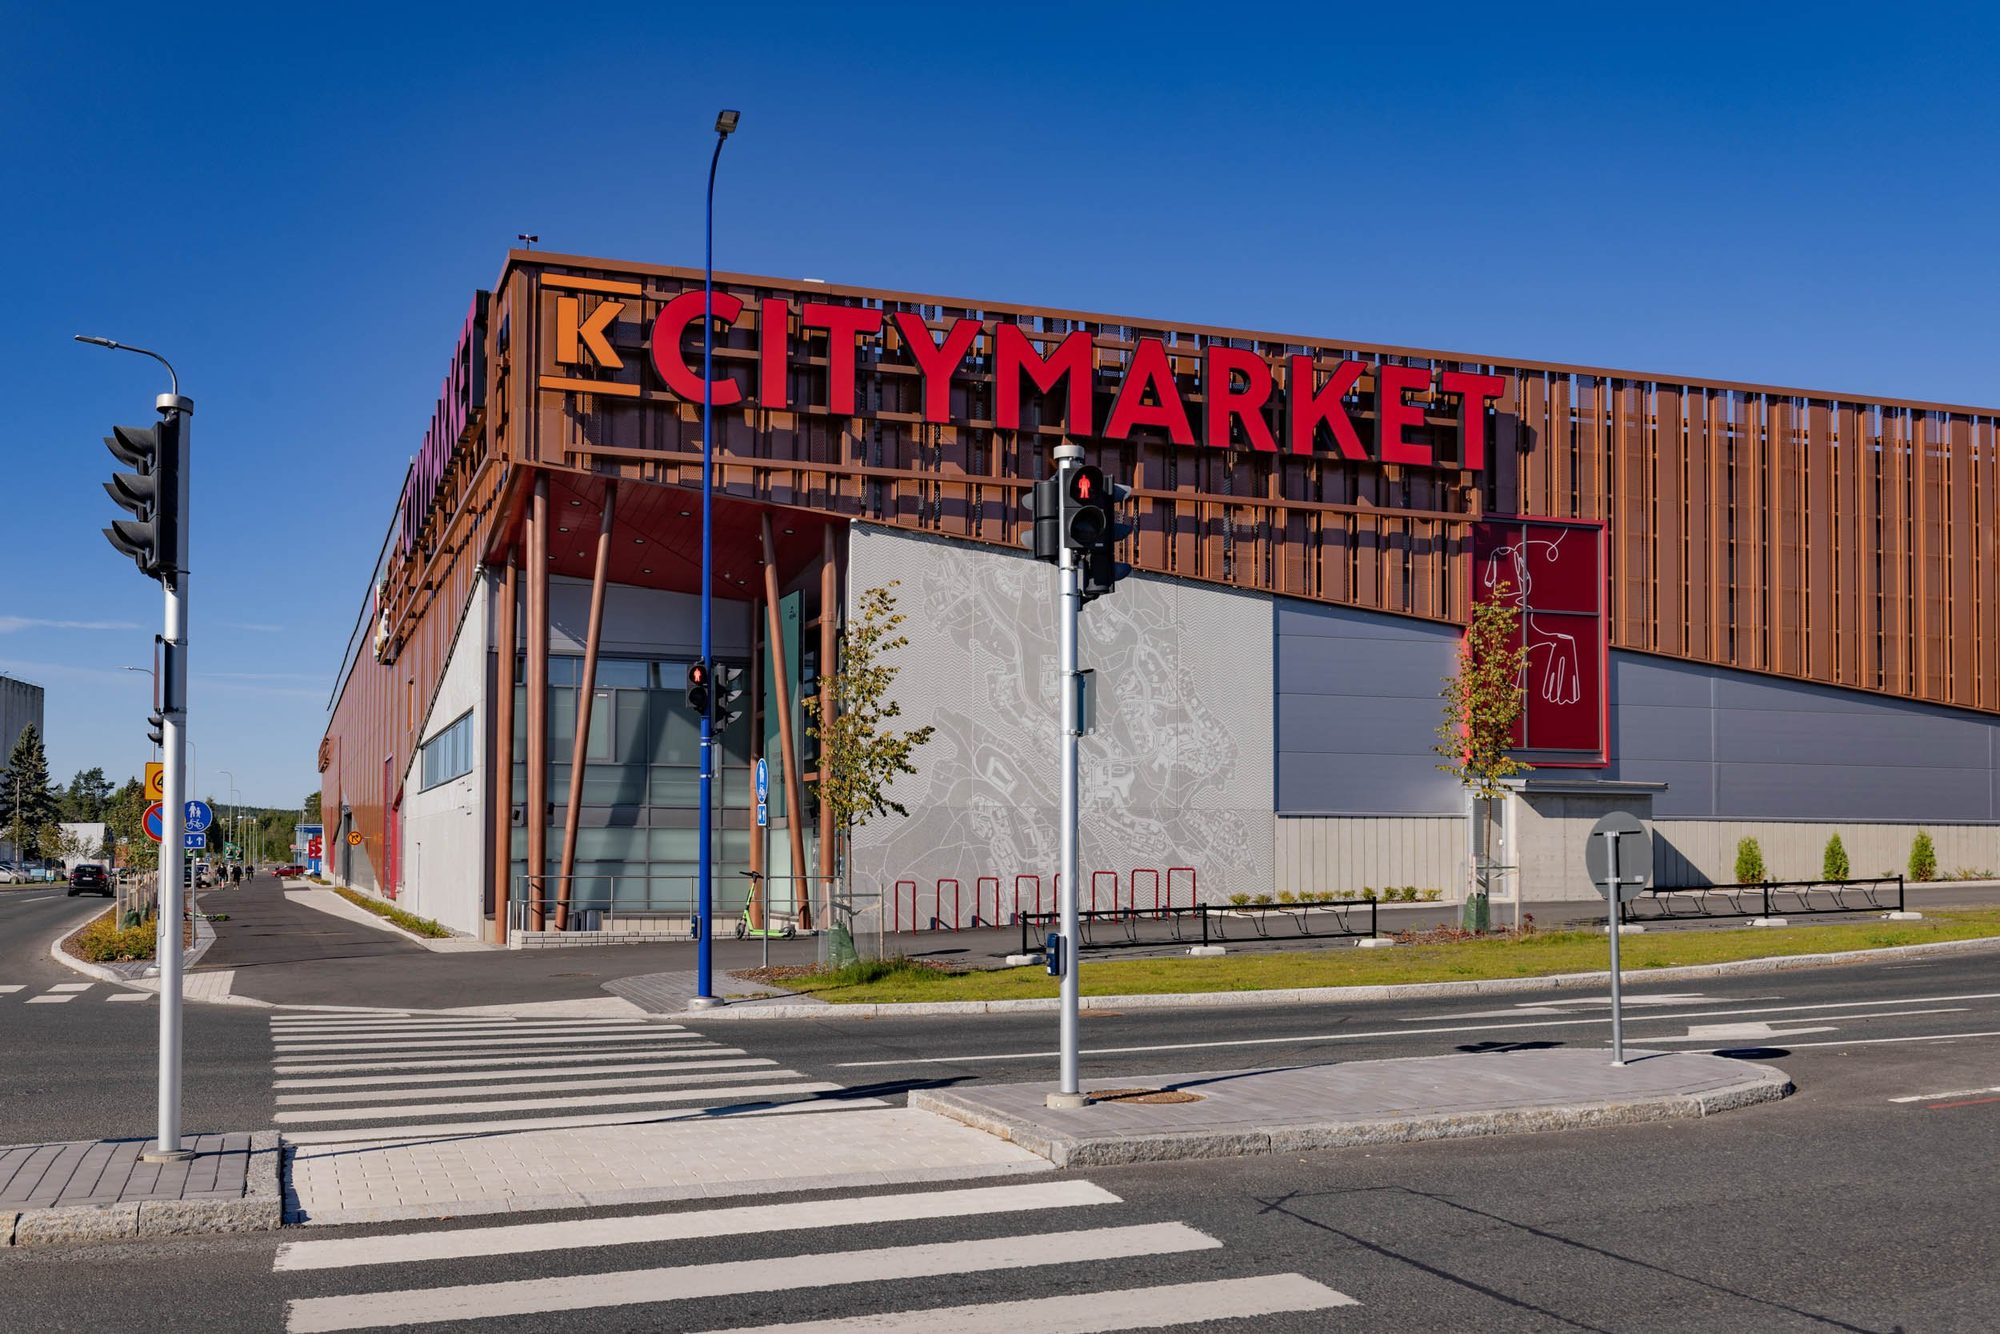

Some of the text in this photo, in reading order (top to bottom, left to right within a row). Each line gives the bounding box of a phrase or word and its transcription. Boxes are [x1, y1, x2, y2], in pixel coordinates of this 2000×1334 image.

[404, 291, 480, 556] CITYMARKET
[556, 290, 1506, 471] K CITYMARKET
